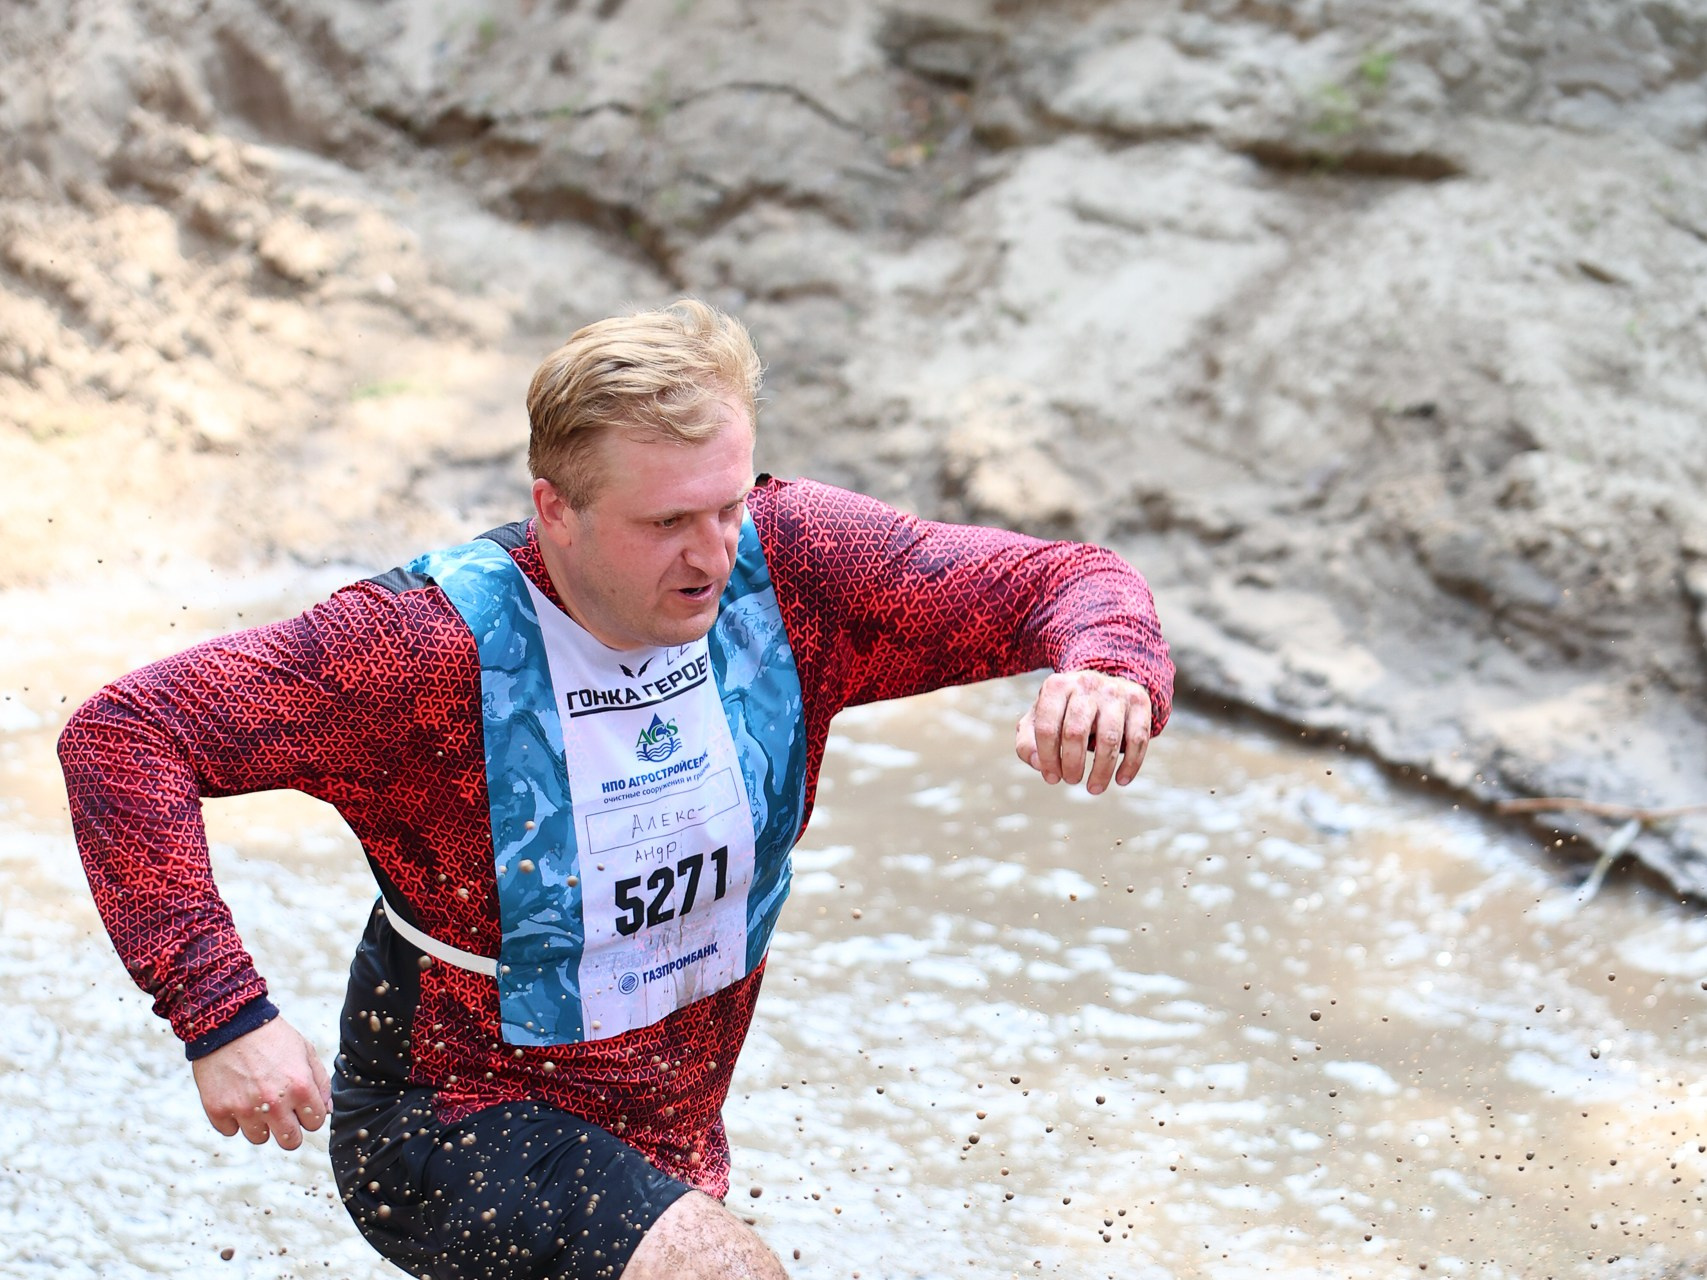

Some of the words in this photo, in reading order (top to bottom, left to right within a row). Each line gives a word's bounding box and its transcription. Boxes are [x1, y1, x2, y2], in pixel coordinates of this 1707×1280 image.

[567, 688, 641, 710] ГОНКА
[601, 780, 626, 793] НПО
[603, 791, 641, 804] очистные
[642, 777, 685, 796] сооружения
[615, 845, 728, 937] 5271
[643, 942, 719, 982] ГАЗПРОМБАНК
